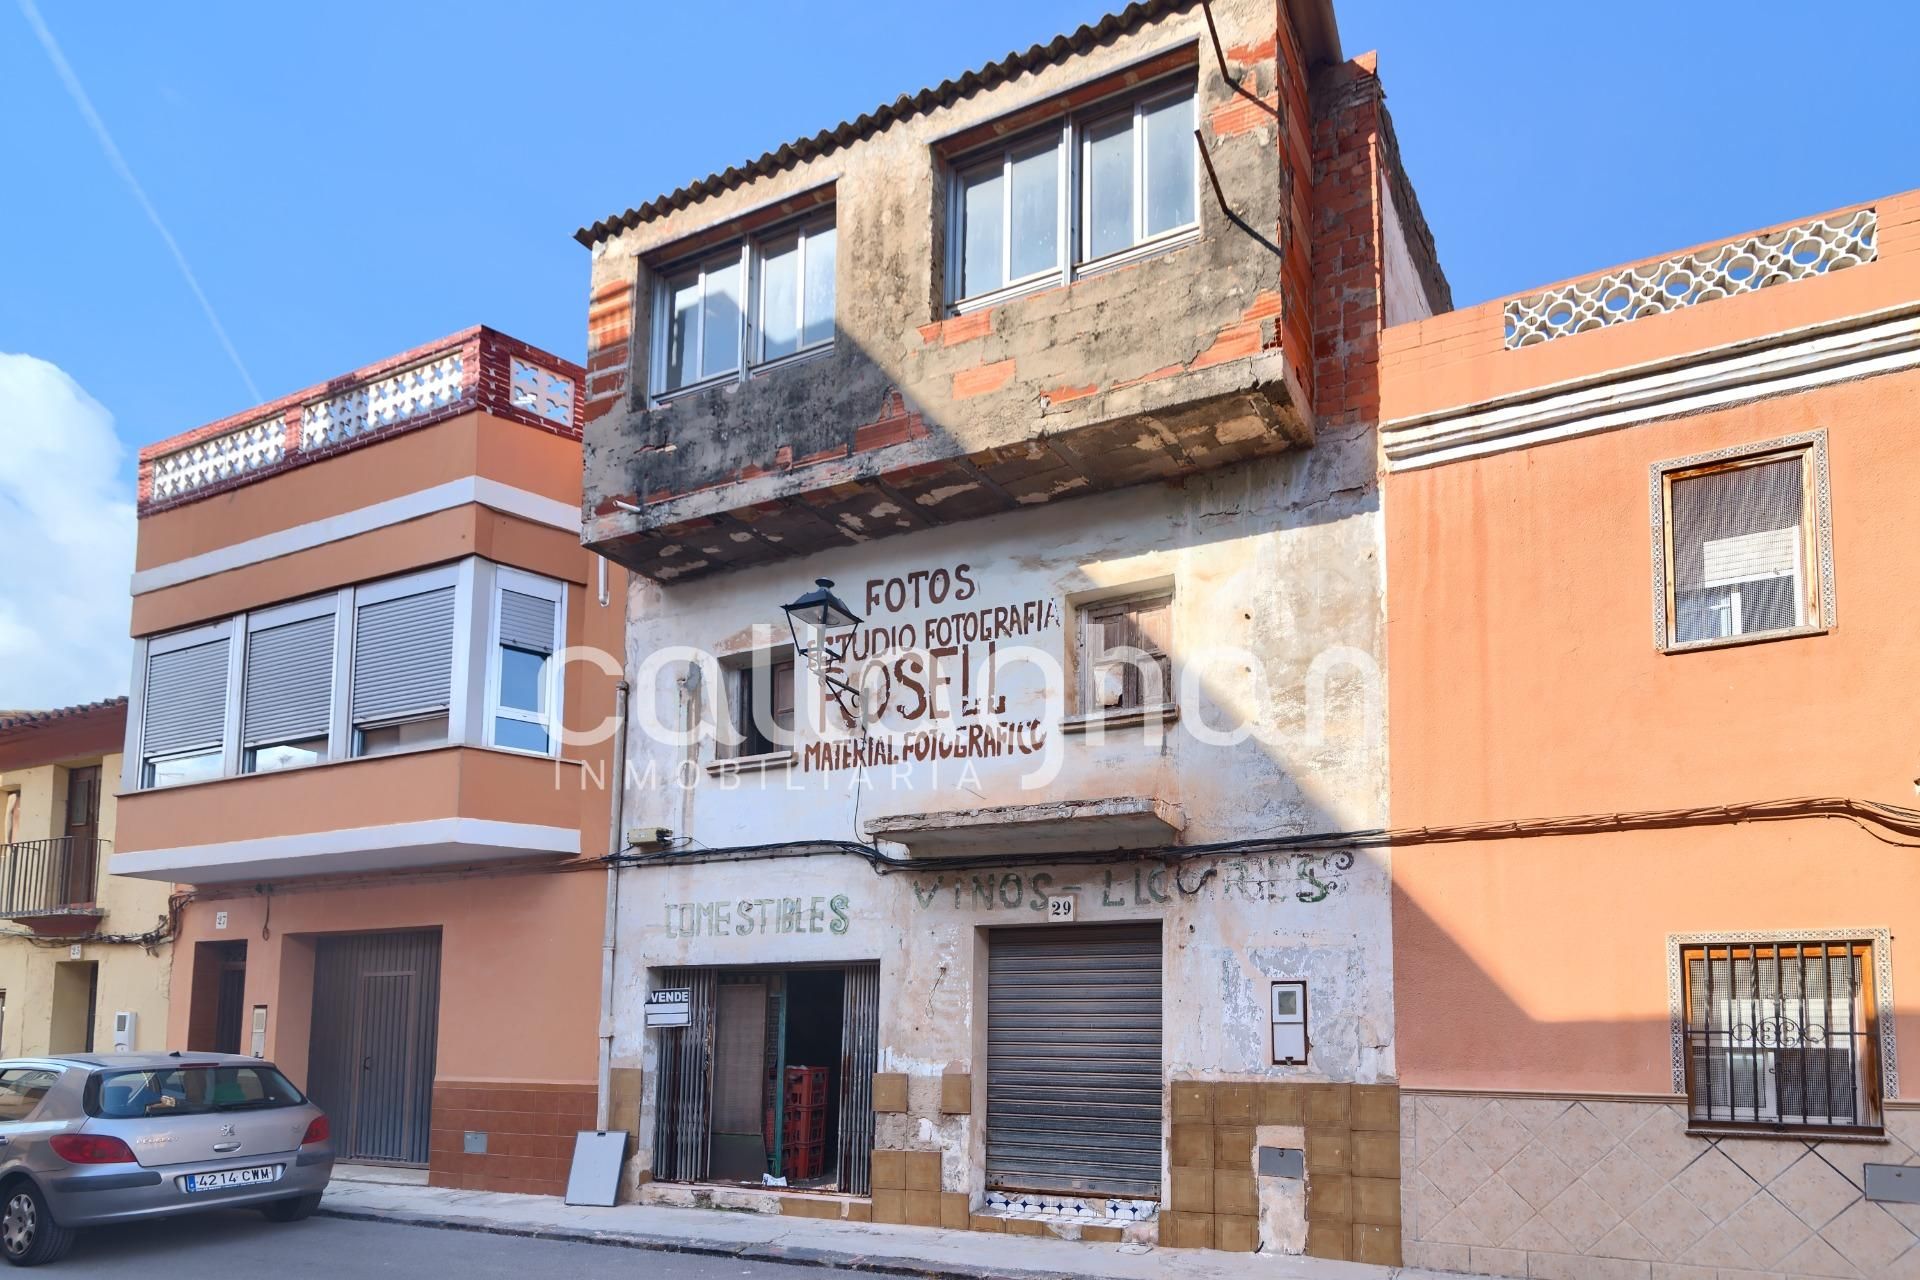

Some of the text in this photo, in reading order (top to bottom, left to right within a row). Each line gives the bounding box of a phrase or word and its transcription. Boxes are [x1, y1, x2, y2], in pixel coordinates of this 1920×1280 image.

[866, 564, 976, 616] FOTOS
[925, 598, 1061, 648] FOTOGRAFIA
[819, 640, 1007, 734] ROSELL
[664, 894, 851, 939] COMESTIBLES
[1051, 899, 1072, 917] 29
[651, 991, 689, 1003] VENDE
[199, 1172, 237, 1187] 4214
[242, 1168, 269, 1182] CWM
